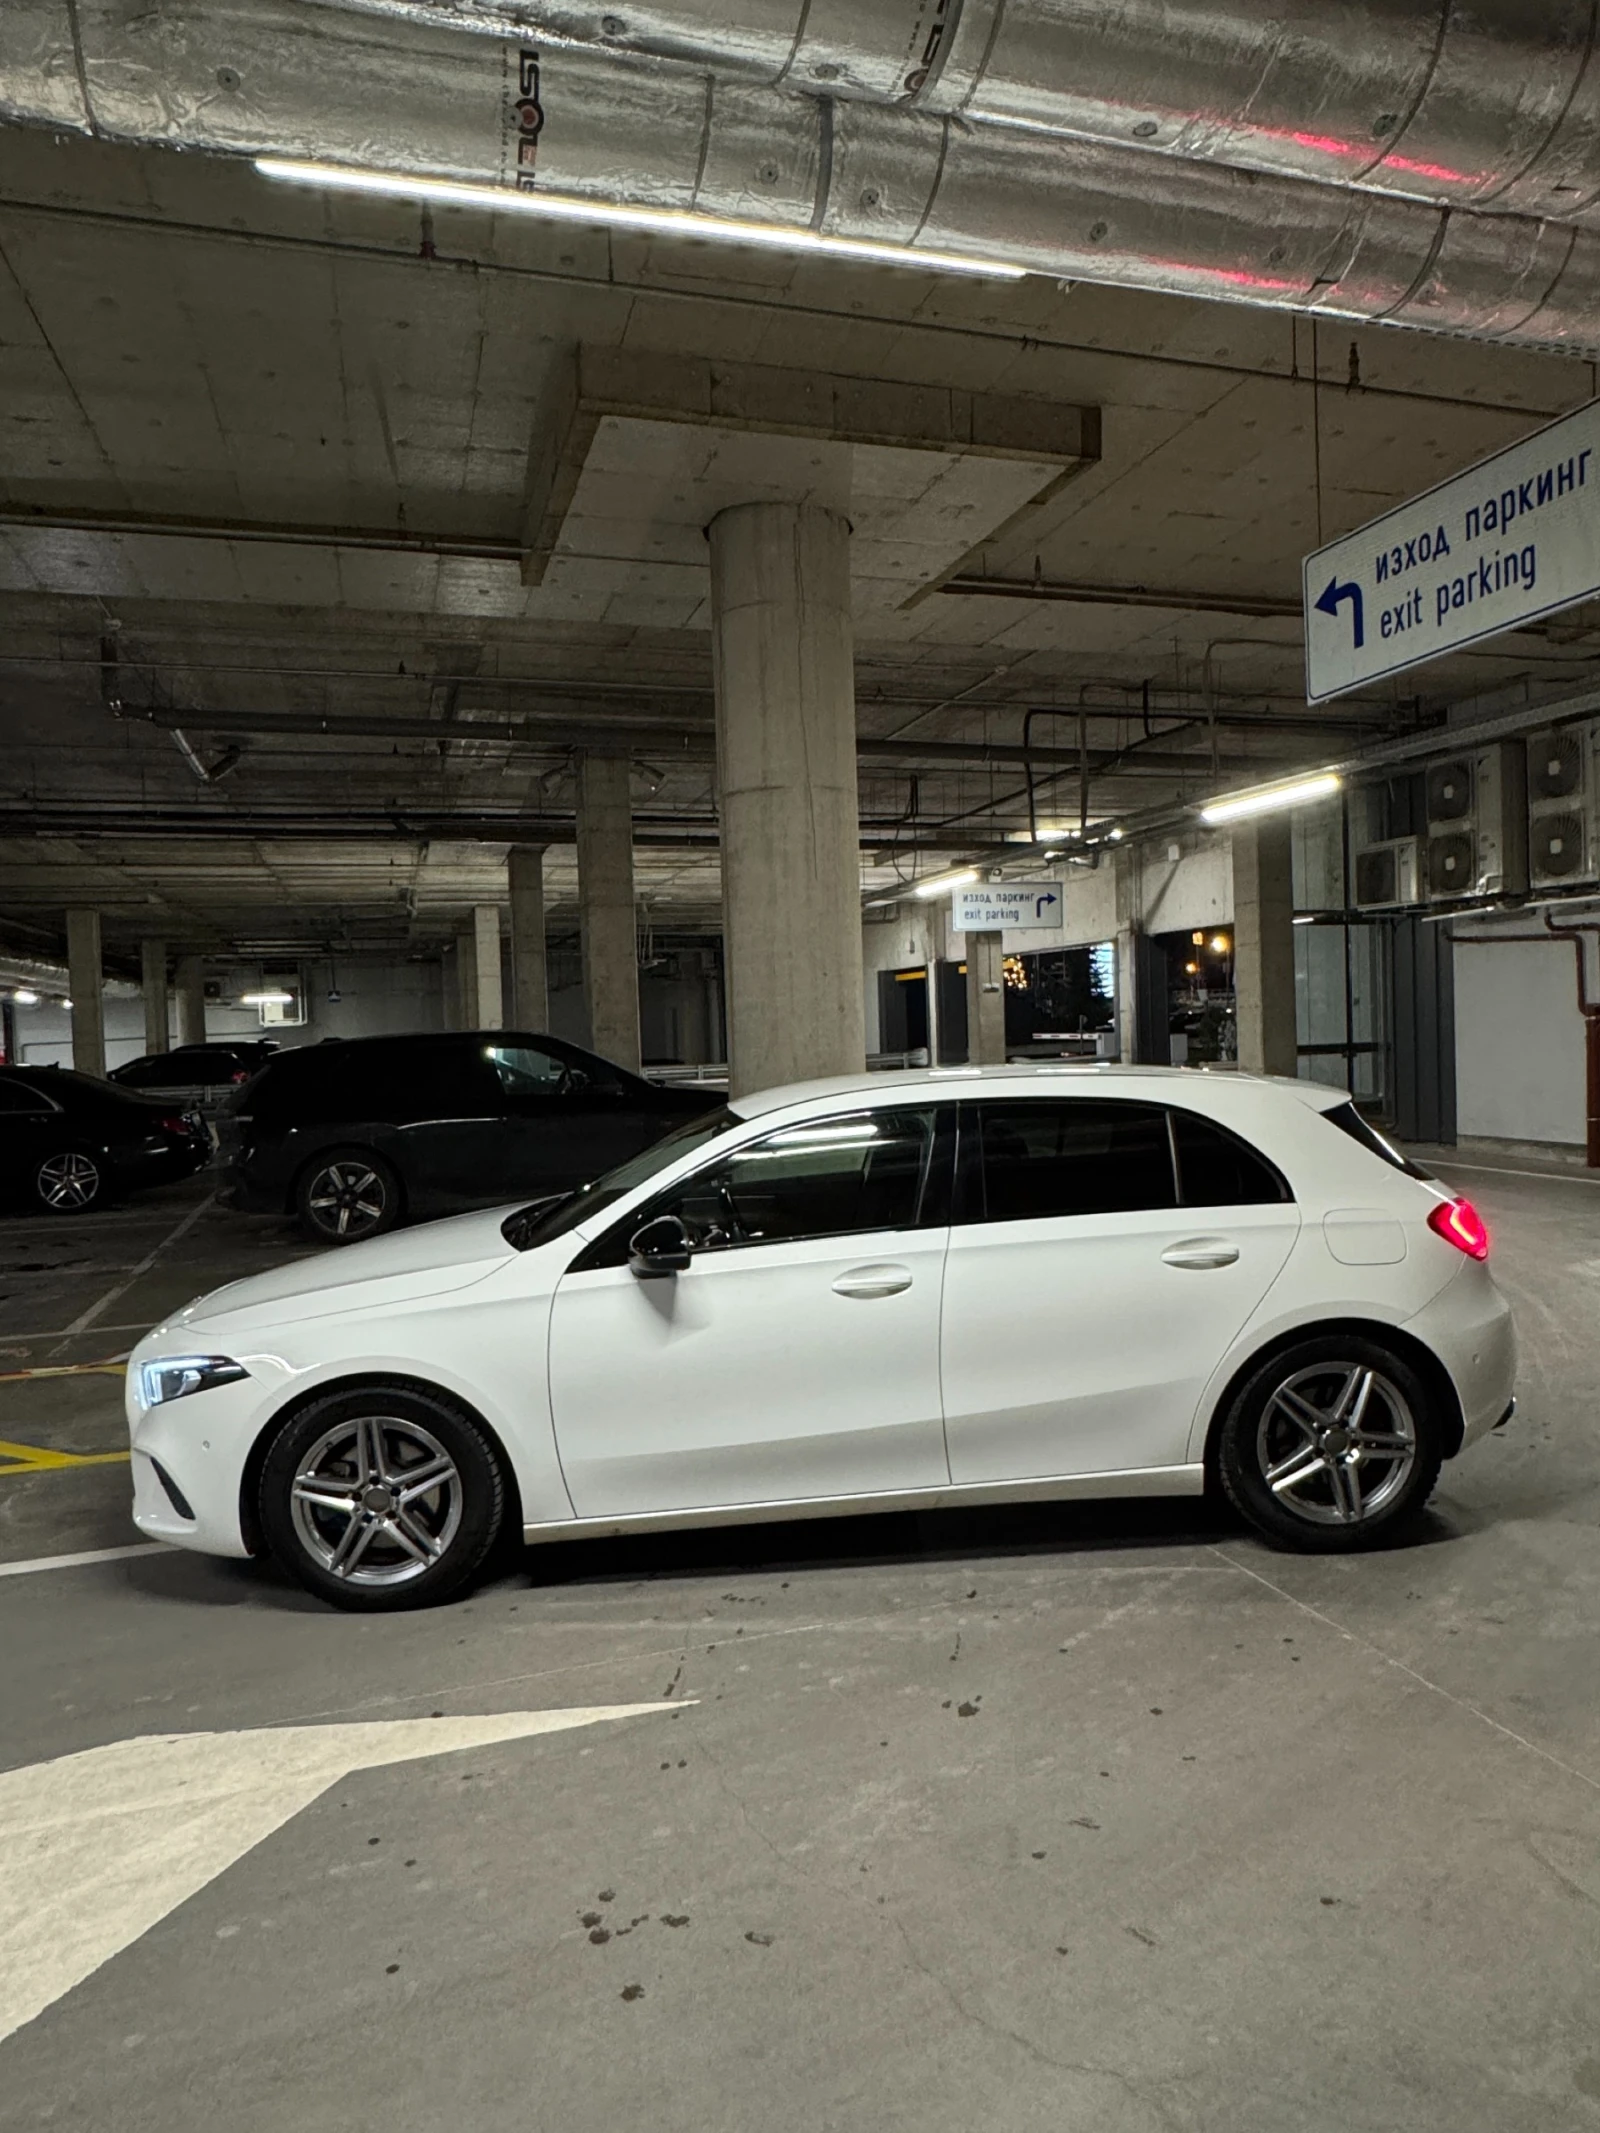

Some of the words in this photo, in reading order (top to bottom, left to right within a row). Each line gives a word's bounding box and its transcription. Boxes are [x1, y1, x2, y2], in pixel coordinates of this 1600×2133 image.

[1376, 525, 1450, 584] изход
[1465, 448, 1592, 541] паркинг
[1380, 587, 1423, 638] exit
[1436, 544, 1536, 626] parking
[963, 893, 992, 904] изход
[996, 892, 1035, 906] паркинг
[964, 909, 981, 920] exit
[985, 909, 1020, 922] parking
